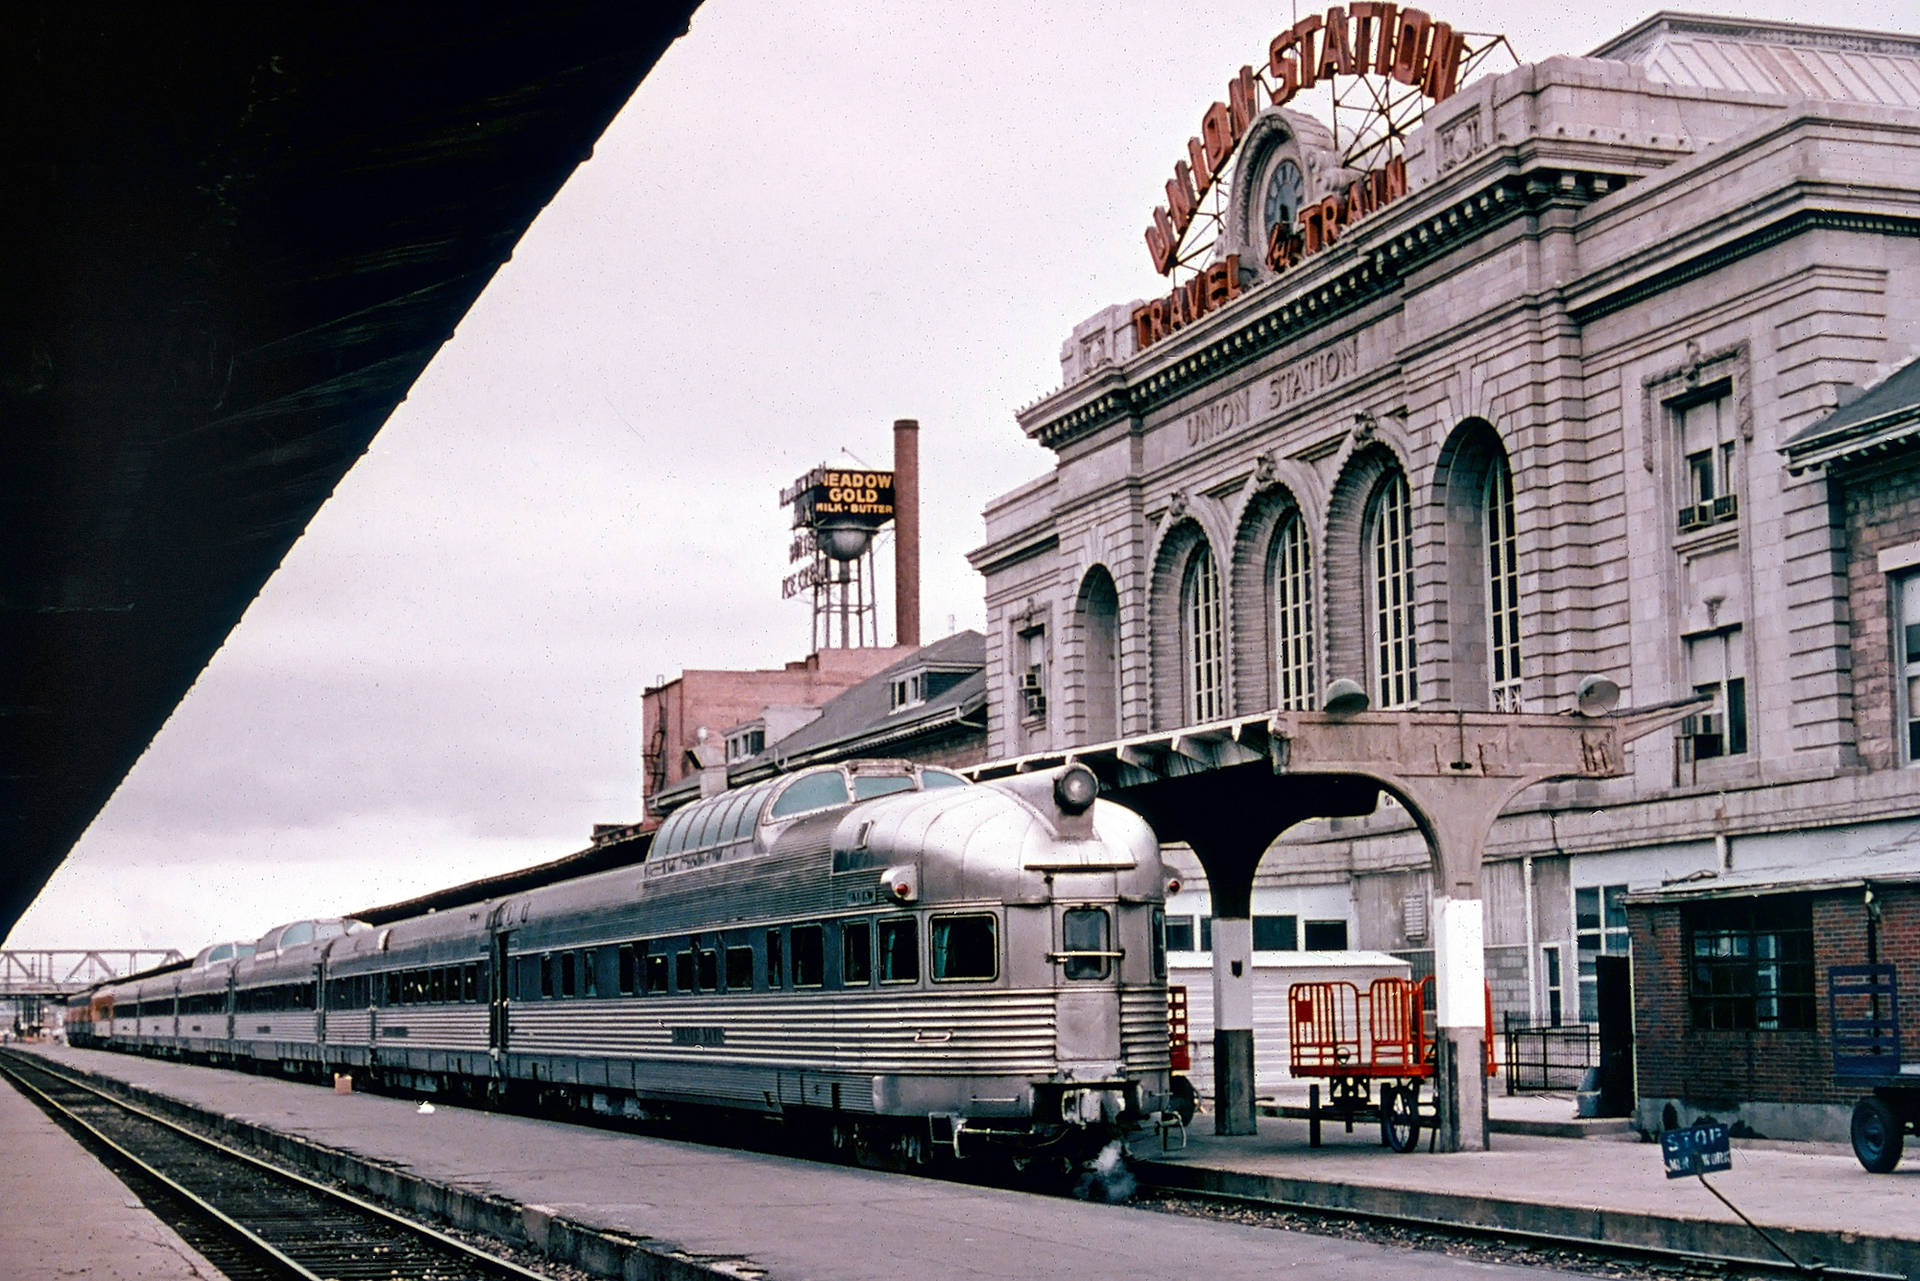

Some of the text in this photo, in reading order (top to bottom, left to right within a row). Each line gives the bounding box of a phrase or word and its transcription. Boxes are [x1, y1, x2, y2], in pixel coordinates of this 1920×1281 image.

[1145, 2, 1464, 277] UNION STATION
[1132, 254, 1241, 350] TRAVEL
[1299, 155, 1406, 256] TRAIN
[1187, 339, 1358, 447] UNION STATION
[816, 502, 893, 514] MILK BUTTER
[829, 488, 878, 503] GOLD
[1667, 1128, 1722, 1151] STOP
